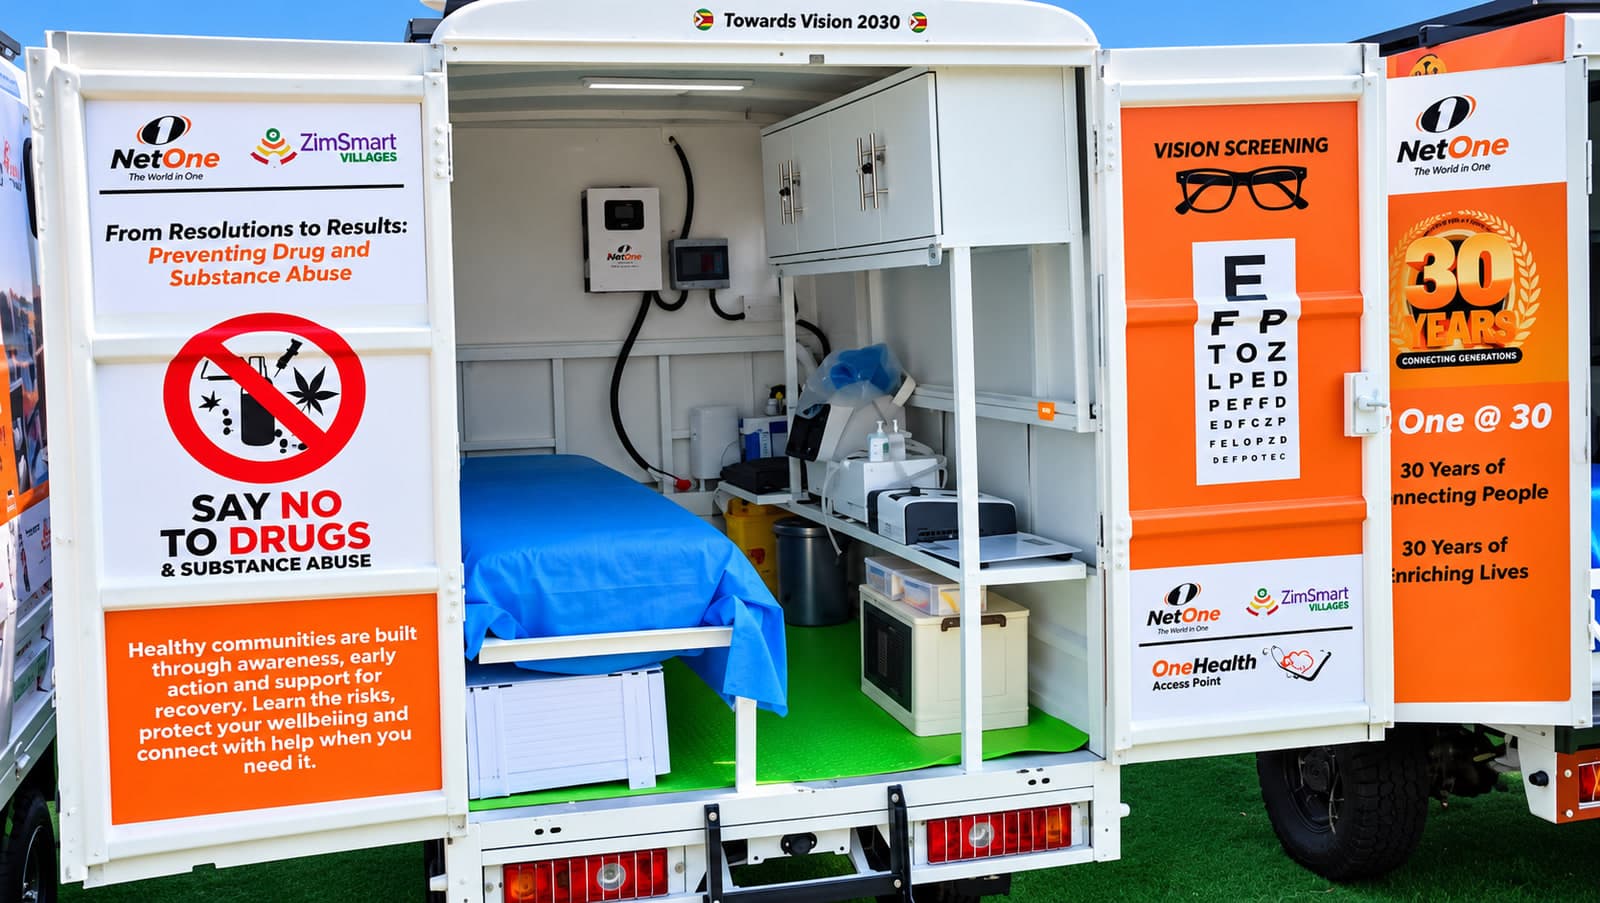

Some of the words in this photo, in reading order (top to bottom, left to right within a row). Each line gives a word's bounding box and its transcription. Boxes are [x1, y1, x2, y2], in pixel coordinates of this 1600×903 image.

[724, 13, 796, 28] Towards
[801, 13, 852, 28] Vision
[858, 15, 900, 29] 2030
[301, 133, 396, 151] ZimSmart
[1155, 141, 1219, 158] VISION
[1224, 137, 1328, 156] SCREENING
[1397, 136, 1509, 163] NetOne
[111, 148, 220, 169] NetOne
[340, 152, 397, 162] VILLAGES
[1433, 164, 1459, 174] World
[106, 225, 161, 241] From
[169, 221, 293, 240] Resolutions
[299, 221, 320, 236] to
[327, 217, 407, 235] Results:
[149, 245, 266, 265] Preventing
[273, 244, 324, 263] Drug
[331, 240, 370, 258] and
[170, 269, 280, 286] Substance
[286, 265, 352, 282] Abuse
[1225, 255, 1267, 301] E
[1404, 233, 1514, 309] 30
[1406, 310, 1518, 349] YEARS
[1402, 355, 1456, 365] CONNECTING
[1459, 352, 1516, 361] GENERATIONS
[1399, 409, 1464, 434] One
[1475, 406, 1501, 432] @
[1510, 403, 1552, 429] 30
[1401, 462, 1424, 478] 30
[1430, 462, 1480, 477] Years
[1486, 458, 1505, 474] of
[192, 493, 270, 522] SAY
[282, 490, 342, 519] NO
[1392, 488, 1476, 506] nnecting
[1483, 483, 1548, 504] People
[160, 528, 217, 557] TO
[230, 522, 370, 554] DRUGS
[1403, 541, 1426, 556] 30
[1432, 540, 1482, 555] Years
[1488, 536, 1508, 553] of
[161, 563, 175, 577] &
[181, 557, 301, 576] SUBSTANCE
[306, 554, 371, 570] ABUSE
[1480, 564, 1528, 580] Lives
[1282, 587, 1349, 604] ZimSmart
[1309, 601, 1349, 611] VILLAGES
[1147, 608, 1220, 626] NetOne
[129, 639, 206, 658] Healthy
[212, 631, 336, 652] communities
[341, 632, 370, 644] are
[376, 625, 416, 642] built
[152, 657, 231, 677] through
[238, 654, 344, 671] awareness,
[350, 647, 396, 665] early
[1153, 654, 1256, 679] OneHealth
[168, 679, 227, 697] action
[234, 675, 269, 692] and
[275, 671, 350, 691] support
[355, 668, 382, 683] for
[1153, 681, 1189, 691] Access
[1193, 677, 1221, 687] Point
[156, 701, 246, 718] recovery.
[253, 696, 305, 711] Learn
[311, 691, 342, 706] the
[348, 688, 394, 704] risks,
[140, 722, 212, 744] protect
[217, 720, 262, 738] your
[267, 710, 367, 730] wellbeiing
[374, 706, 408, 722] and
[137, 742, 218, 761] connect
[223, 736, 265, 754] with
[272, 734, 314, 752] help
[320, 730, 371, 746] when
[377, 730, 411, 746] you
[244, 755, 292, 773] need
[298, 754, 316, 769] it.
